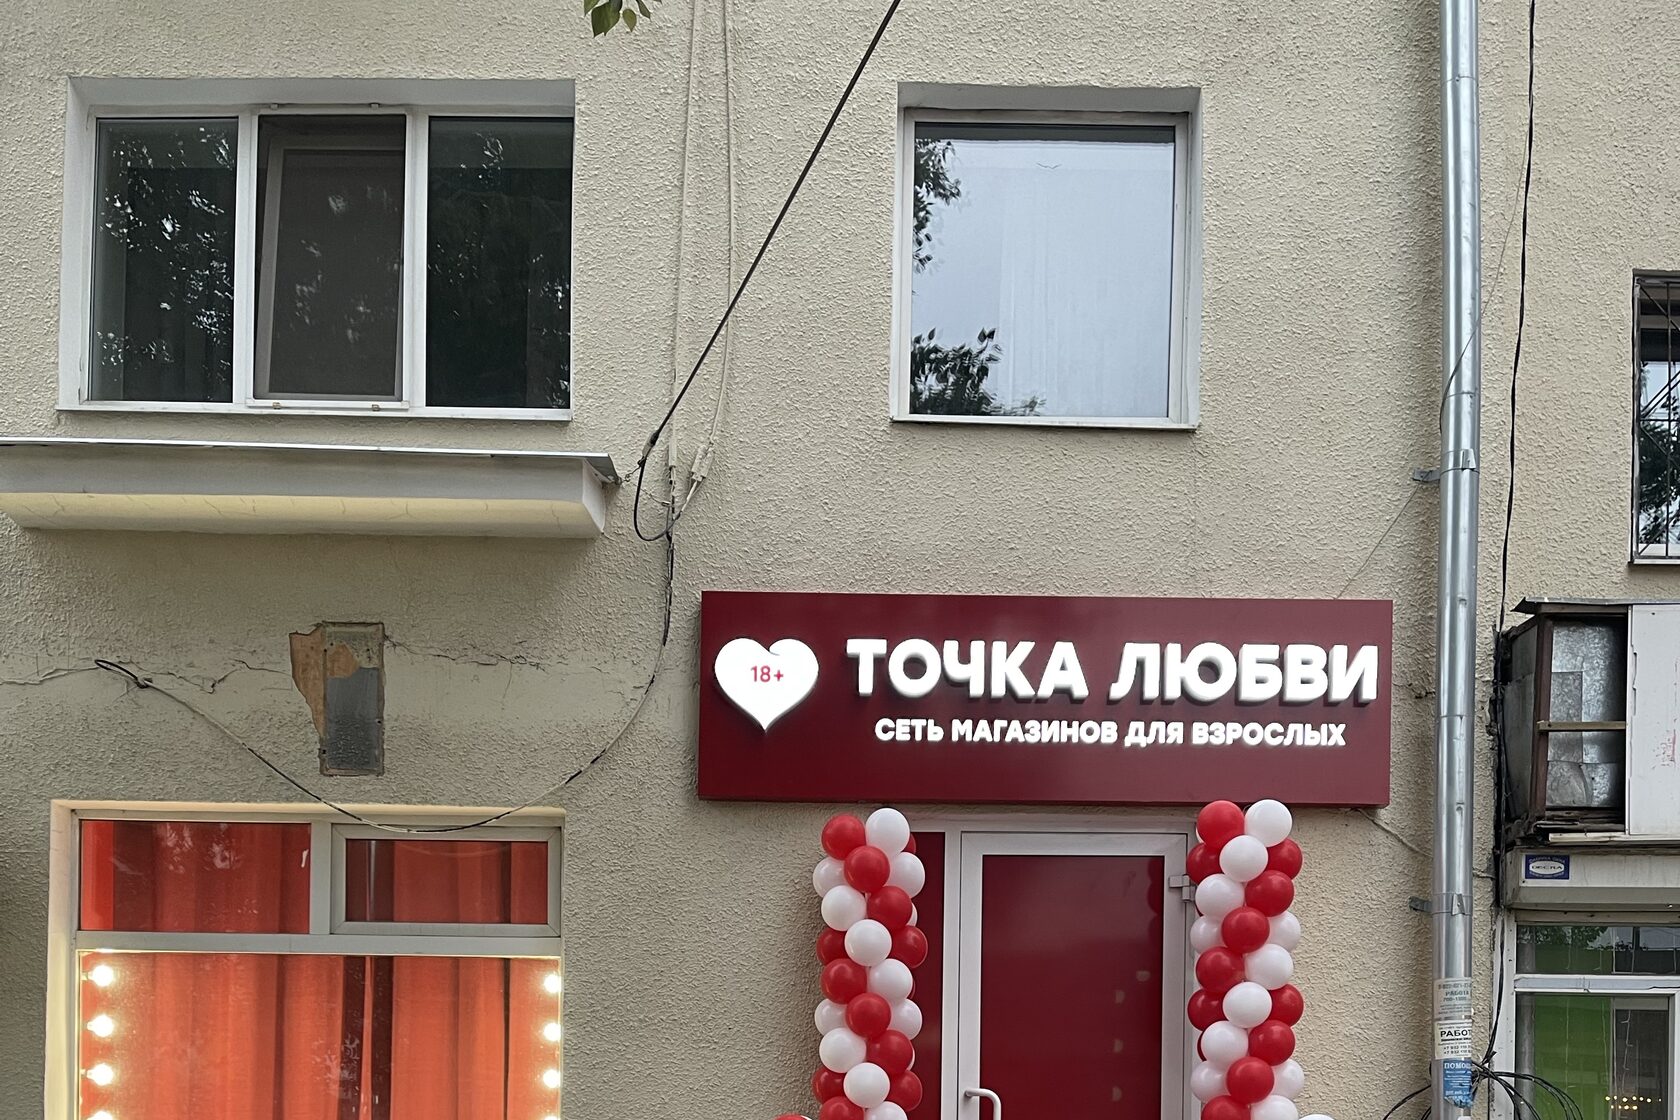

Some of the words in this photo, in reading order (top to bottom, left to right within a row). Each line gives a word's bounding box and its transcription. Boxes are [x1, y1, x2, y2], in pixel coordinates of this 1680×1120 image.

[750, 665, 784, 683] 18+
[846, 638, 1090, 698] ТОЧКА
[1109, 641, 1380, 702] ЛЮБВИ
[874, 718, 945, 742] СЕТЬ
[951, 719, 1118, 744] МАГАЗИНОВ
[1124, 721, 1184, 748] ДЛЯ
[1191, 722, 1347, 747] ВЗРОСЛЫХ
